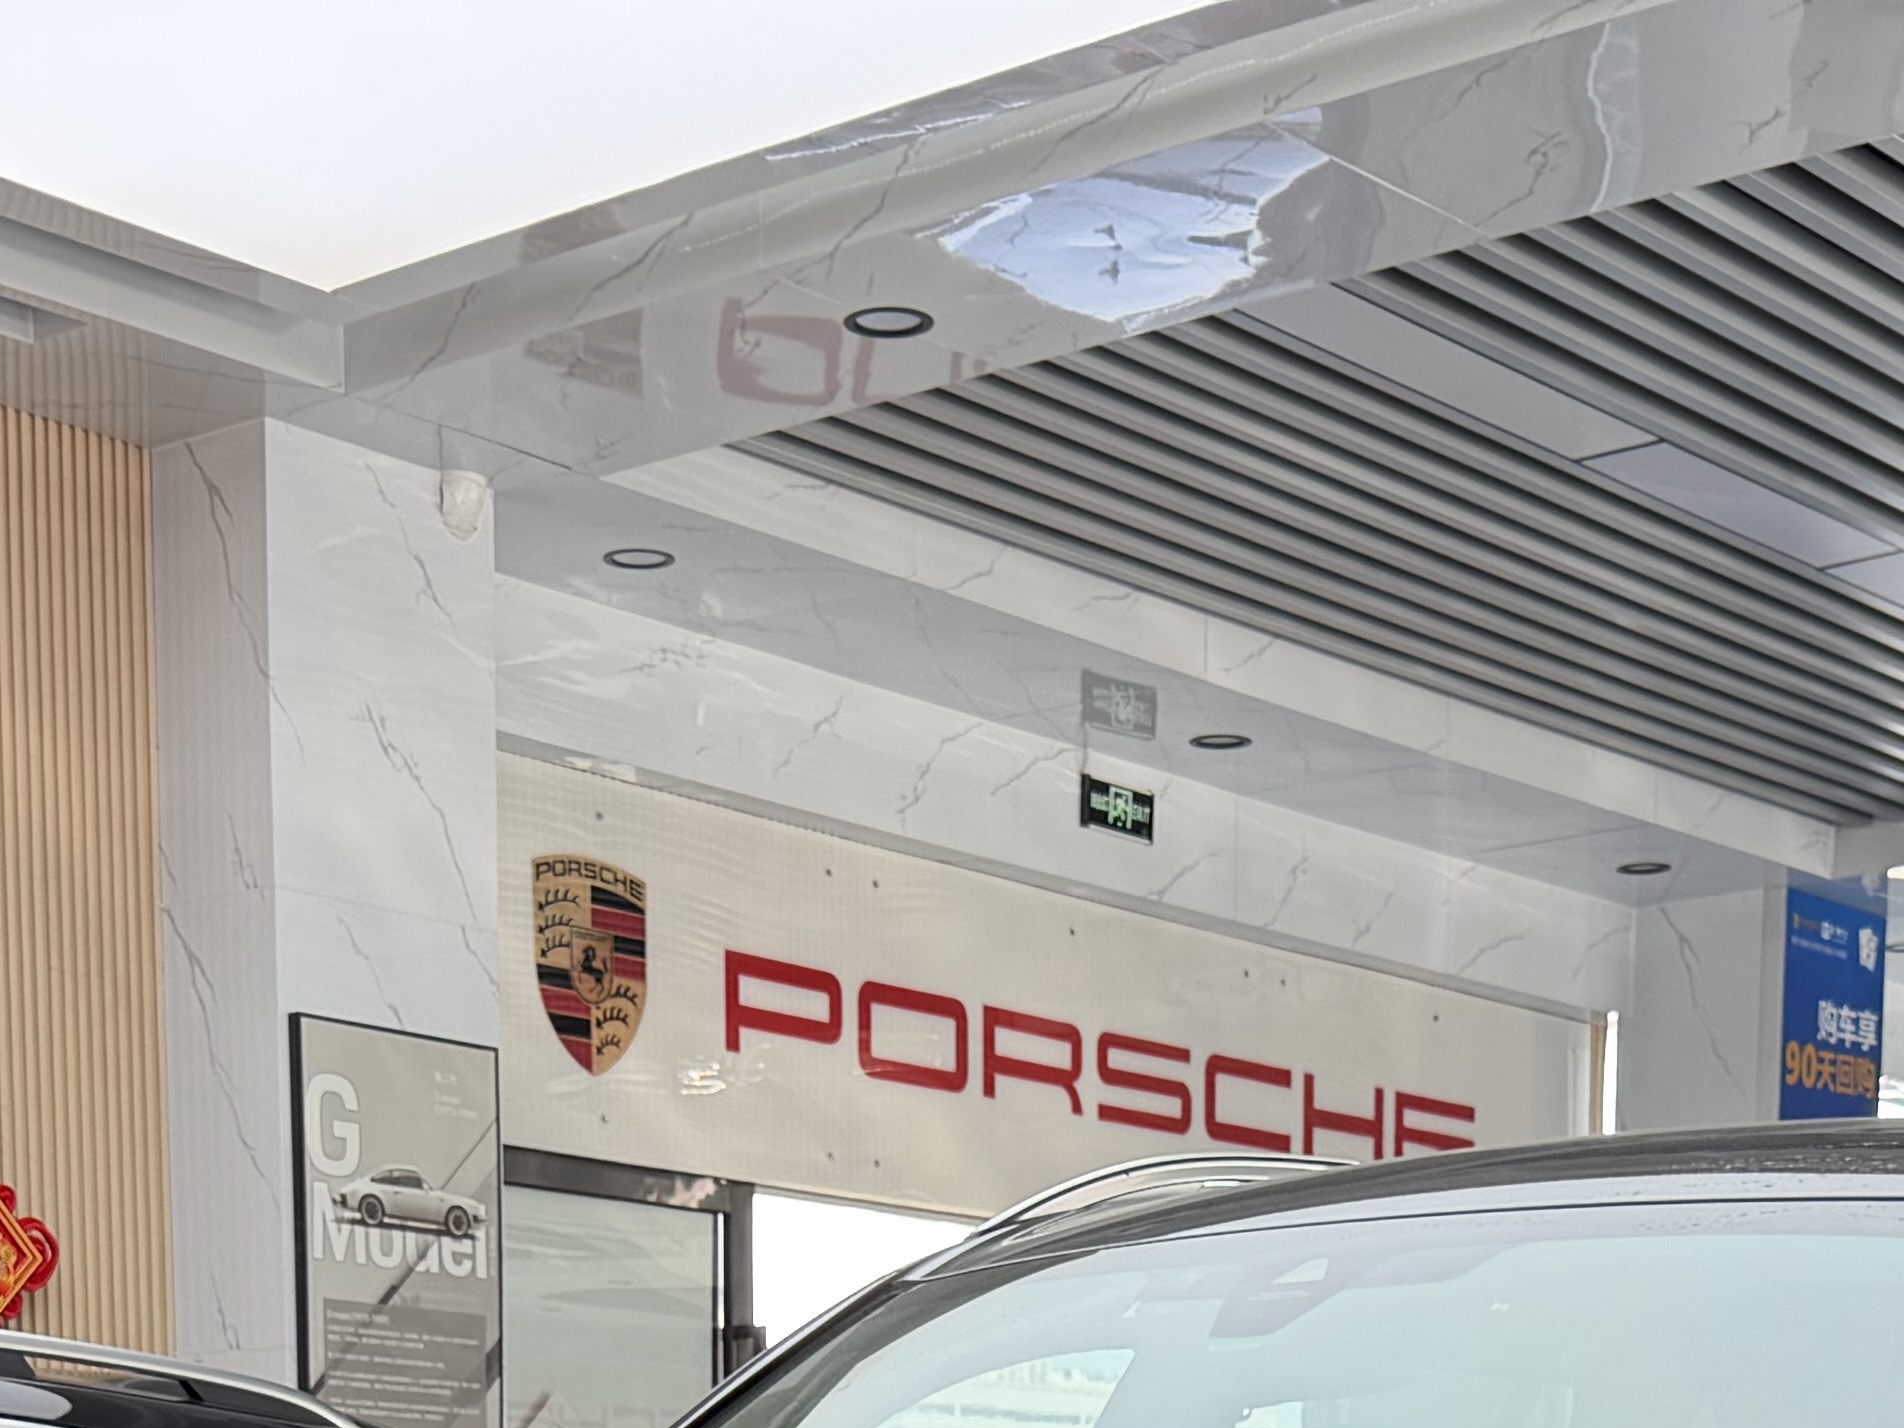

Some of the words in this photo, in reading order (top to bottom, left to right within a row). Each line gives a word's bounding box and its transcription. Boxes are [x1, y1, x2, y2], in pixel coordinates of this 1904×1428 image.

[535, 859, 644, 903] PORSCHE
[723, 949, 1476, 1160] PORSCHE
[1817, 999, 1879, 1052] 购车享
[307, 1073, 361, 1177] G
